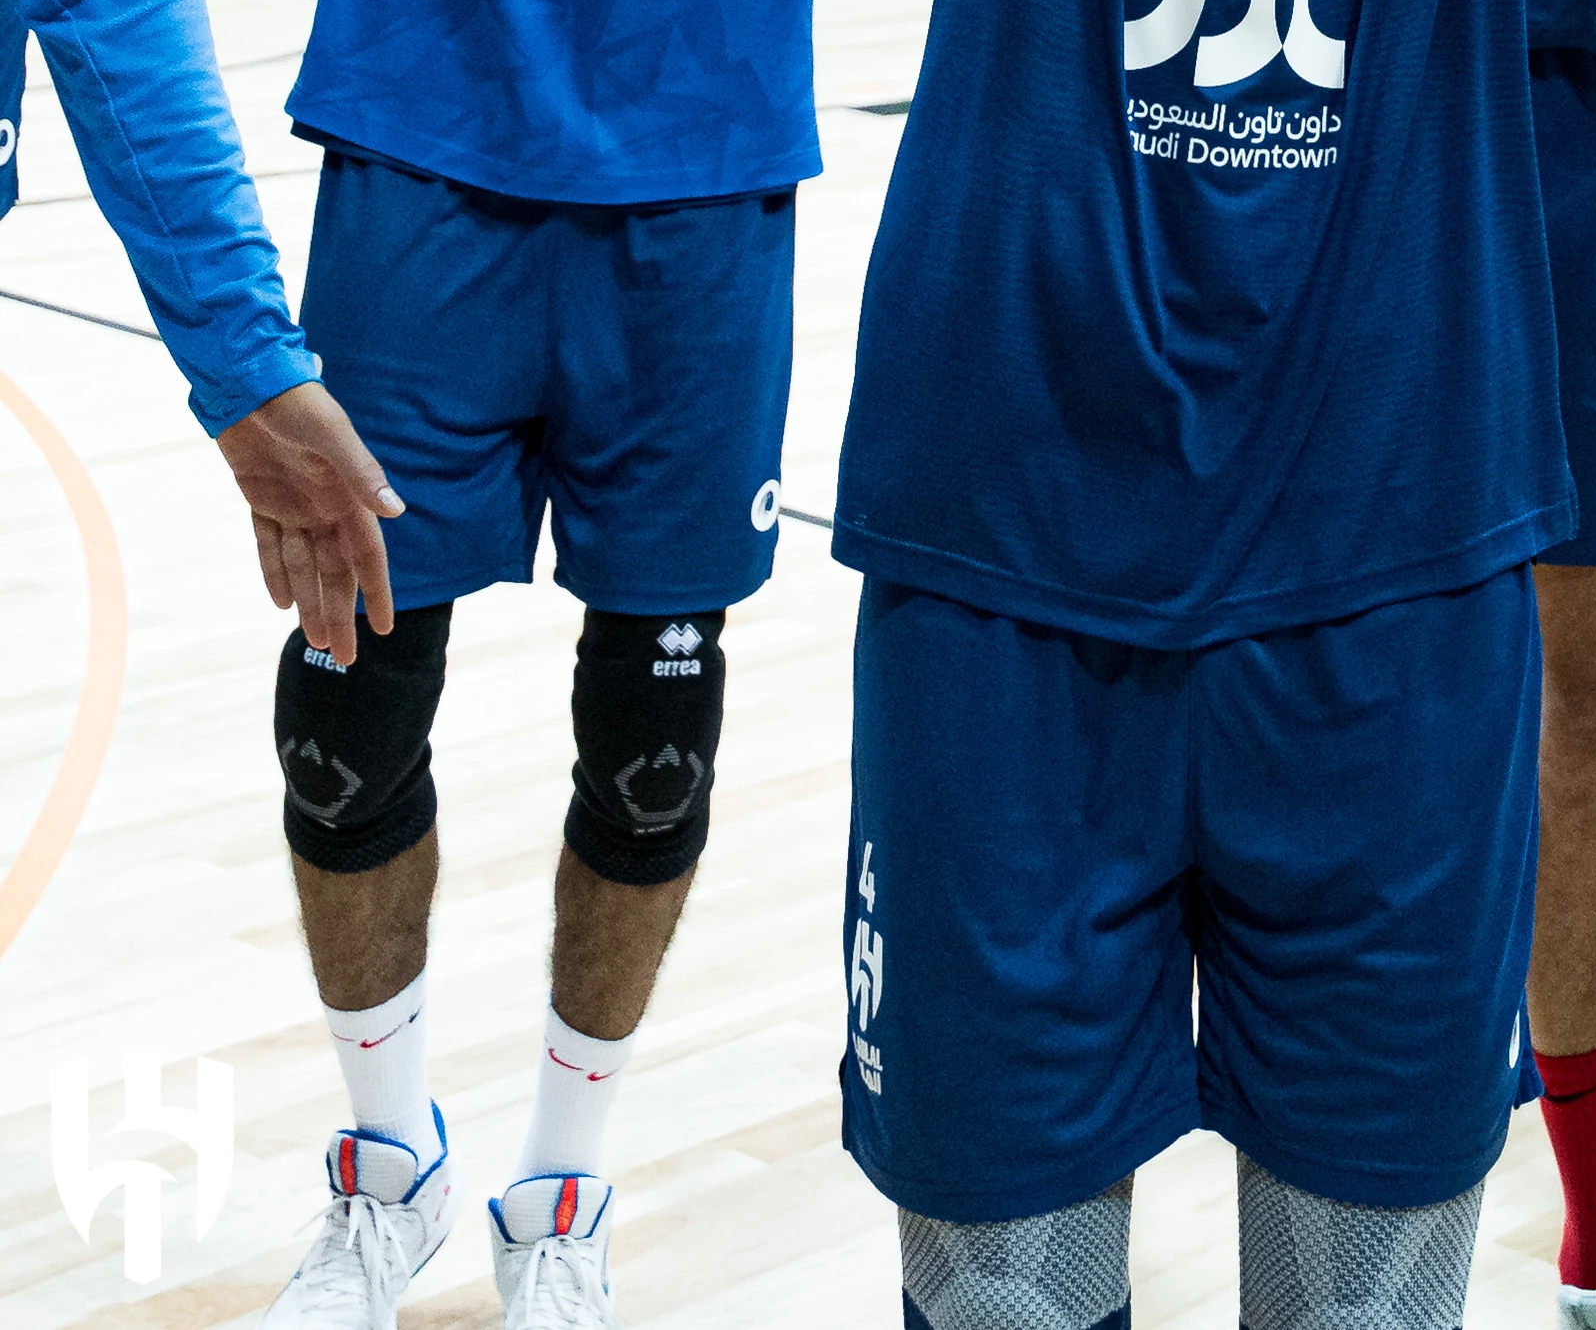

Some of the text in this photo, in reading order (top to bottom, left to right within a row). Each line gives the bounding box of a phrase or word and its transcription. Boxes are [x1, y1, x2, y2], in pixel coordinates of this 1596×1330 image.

[1126, 99, 1342, 144] داون تاون السعودي
[1187, 137, 1338, 169] Downtown
[652, 659, 701, 676] errea
[859, 841, 876, 914] 4
